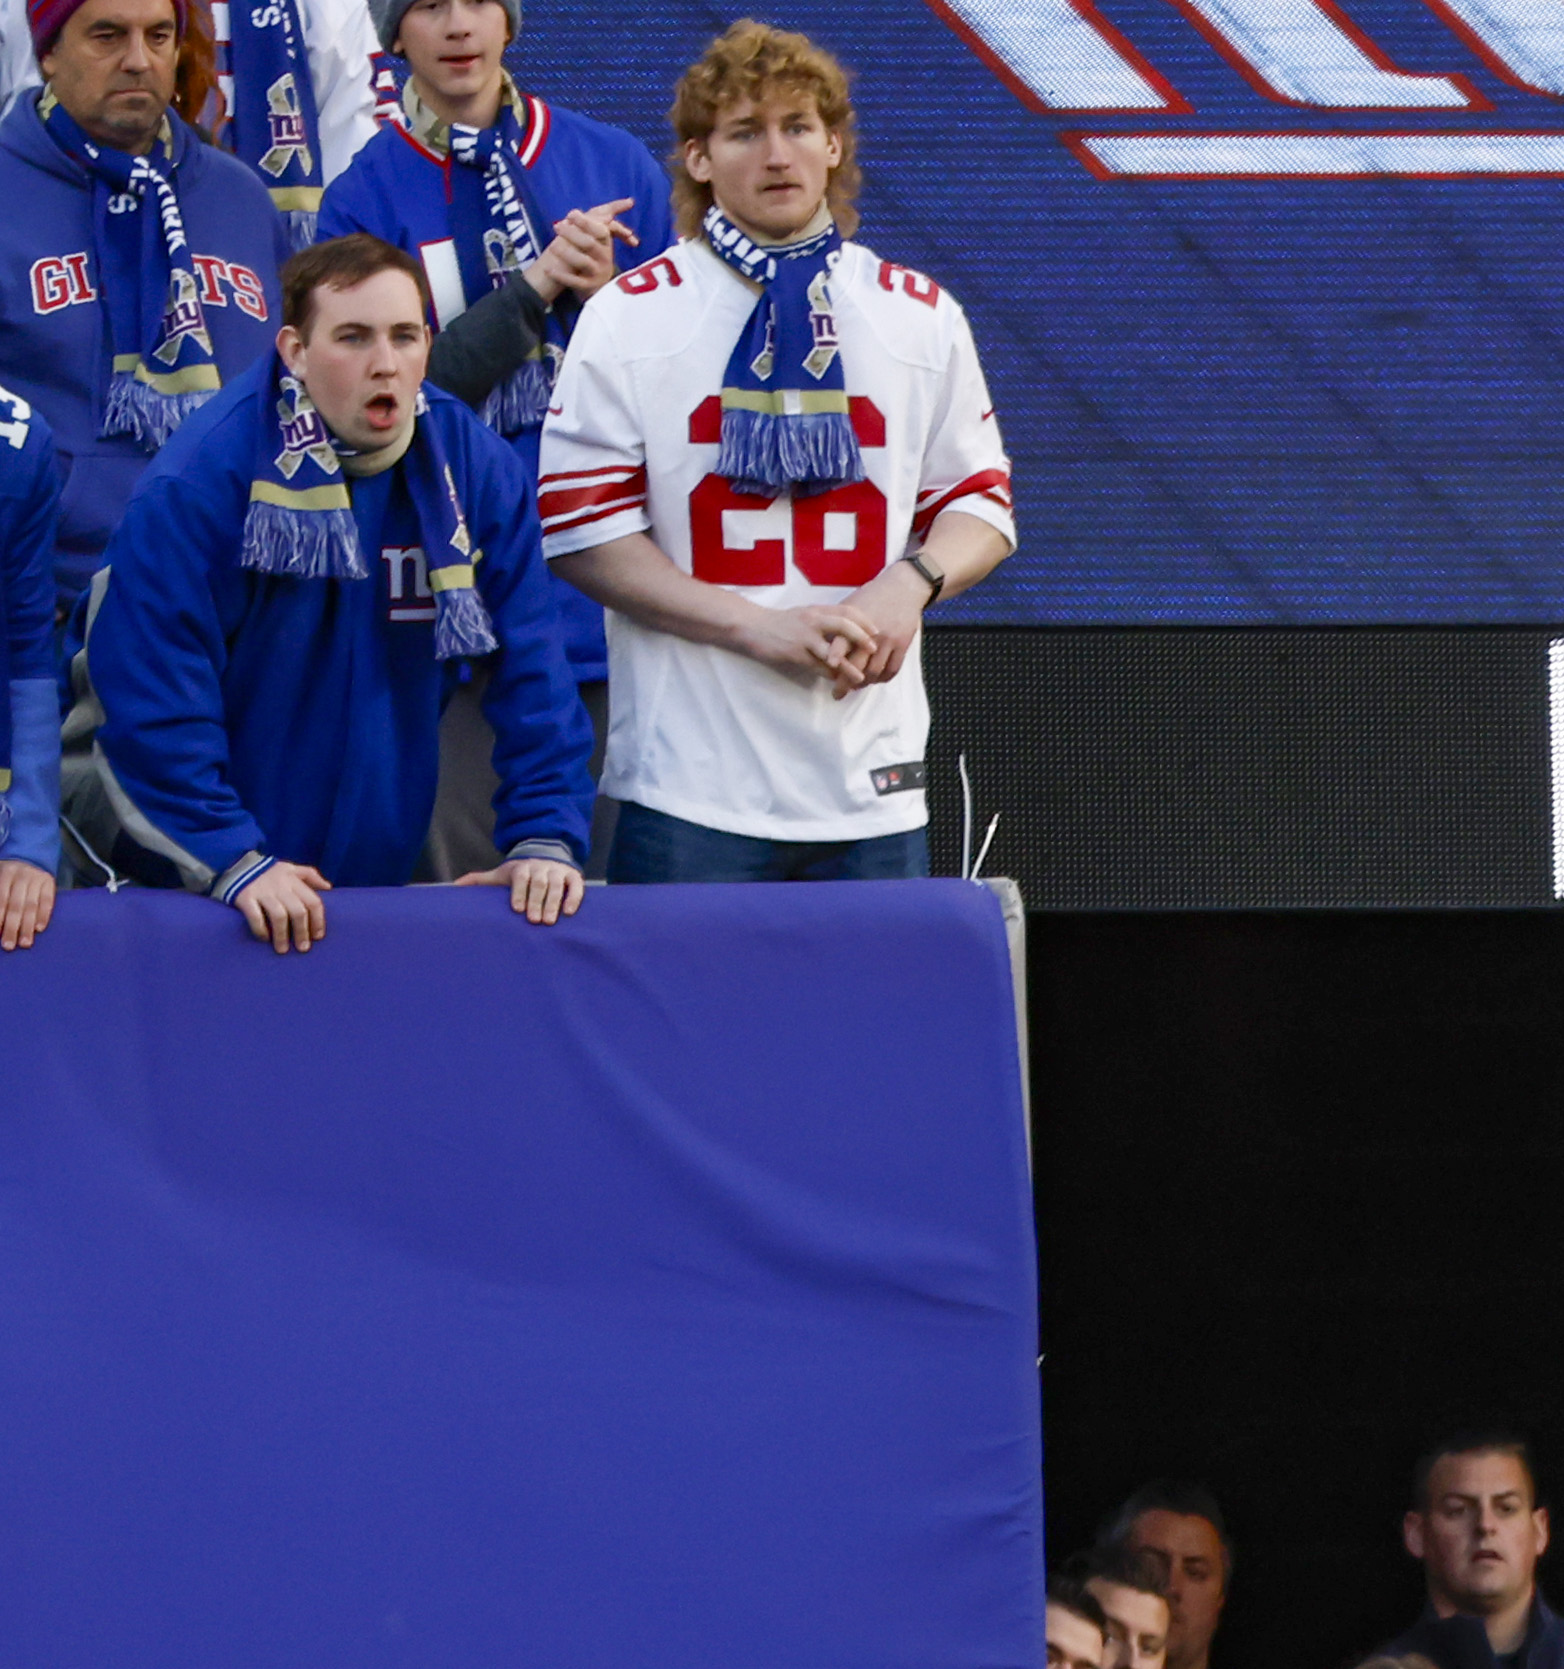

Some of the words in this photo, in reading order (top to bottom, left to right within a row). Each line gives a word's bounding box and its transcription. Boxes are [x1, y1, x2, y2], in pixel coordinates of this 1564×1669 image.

[30, 251, 269, 322] GITS
[688, 395, 888, 588] 26
[381, 544, 436, 622] n
